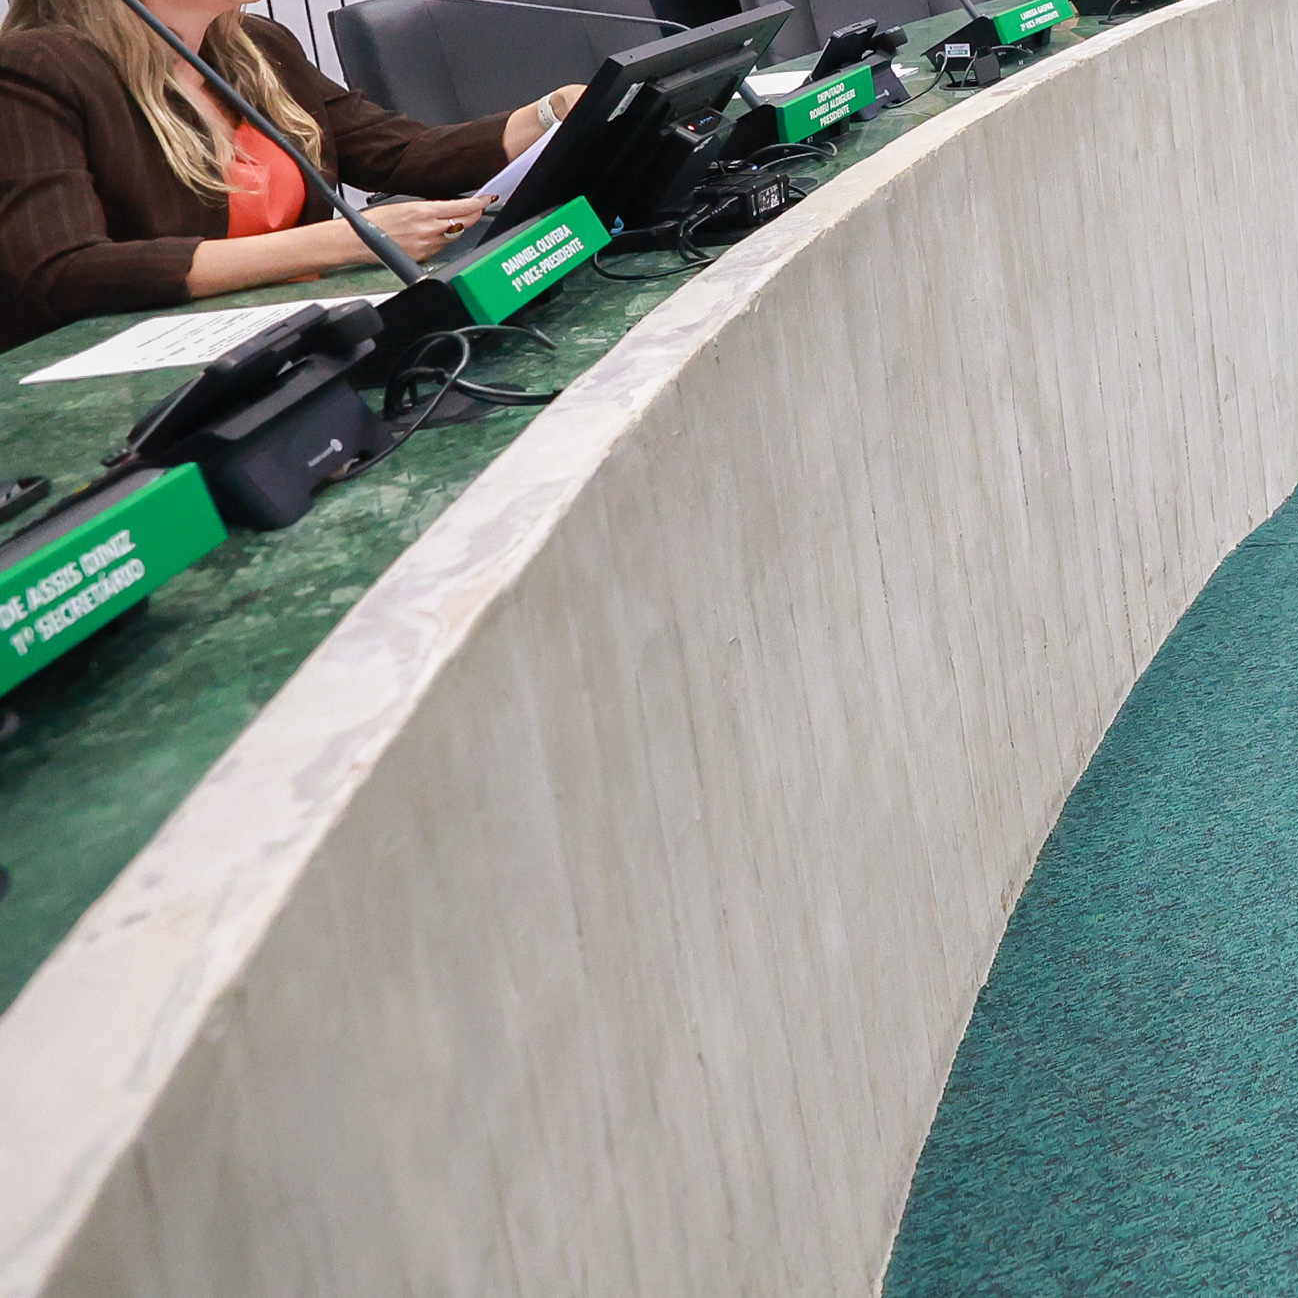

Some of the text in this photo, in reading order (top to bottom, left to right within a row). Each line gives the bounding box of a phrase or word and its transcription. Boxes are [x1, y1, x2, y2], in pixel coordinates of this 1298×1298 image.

[1037, 2, 1054, 14] GASPAR
[817, 82, 845, 103] DEPUTADO
[809, 102, 830, 120] ROMEU
[819, 104, 850, 127] PRESIDENTE
[501, 224, 573, 276] DANNIEL OLIVEIRA
[520, 237, 584, 286] VICE-PRESIDENTE
[25, 561, 83, 613] ASSIS
[79, 529, 137, 577] DINIZ
[34, 557, 146, 642] SECRETÁRIO
